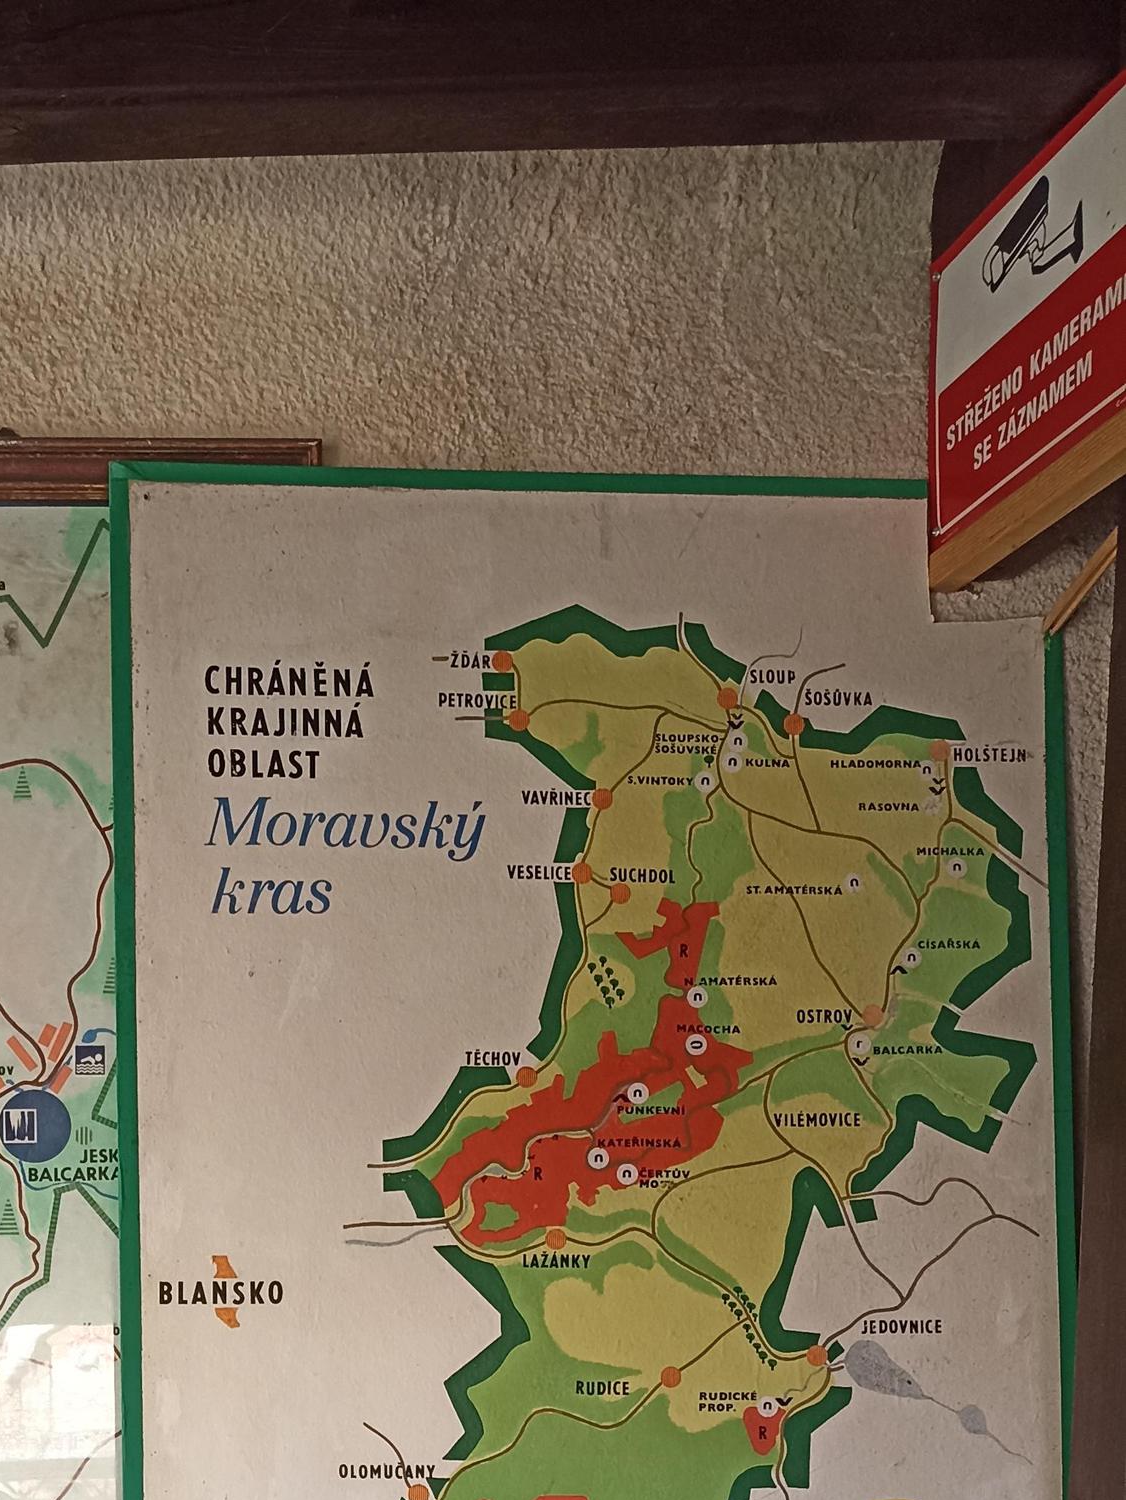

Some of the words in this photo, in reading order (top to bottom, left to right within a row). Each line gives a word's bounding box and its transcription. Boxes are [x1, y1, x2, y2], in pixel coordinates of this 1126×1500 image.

[946, 364, 1023, 451] STŘEŽENO
[973, 434, 992, 470] SE
[997, 350, 1093, 451] ZÁZNAMEM
[450, 650, 491, 669] ŽĎÁR
[204, 659, 374, 698] CHRÁNĚNÁ
[749, 669, 796, 685] SLOUP
[438, 692, 517, 710] PETROVICE
[804, 688, 873, 706] ŠOŠŮVKA
[207, 702, 364, 738] KRAJINNÁ
[953, 744, 1026, 763] HOLŠTEJN
[207, 748, 320, 779] OBLAST
[830, 759, 922, 769] HLADOMORNA
[522, 787, 592, 807] VAVŘINEC
[858, 802, 920, 812] RASOVNA
[204, 796, 486, 862] Moravský
[916, 847, 985, 857] MICHALKA
[507, 864, 572, 881] VESELICE
[609, 867, 676, 884] SUCHDOL
[211, 866, 333, 915] kras
[765, 884, 843, 896] AMATÉRSKÁ
[679, 944, 689, 958] R
[796, 1009, 853, 1024] OSTROV
[676, 1024, 740, 1035] MACOCHA
[465, 1049, 521, 1066] TĚCHOV
[873, 1045, 943, 1055] BALCARKA
[774, 1110, 861, 1127] VILÉMOVICE
[597, 1137, 682, 1148] KATEŘINSKÁ
[534, 1167, 543, 1181] R
[638, 1167, 690, 1179] ČERTŮV
[523, 1252, 591, 1269] LAŽÁNKY
[158, 1280, 284, 1305] BLANSKO
[861, 1319, 942, 1335] JEDOVNICE
[575, 1380, 630, 1396] RUDICE
[698, 1389, 757, 1401] RUDICKÉ
[698, 1402, 737, 1412] PROP.
[758, 1425, 768, 1441] R
[338, 1461, 436, 1479] OLOMUČANY
